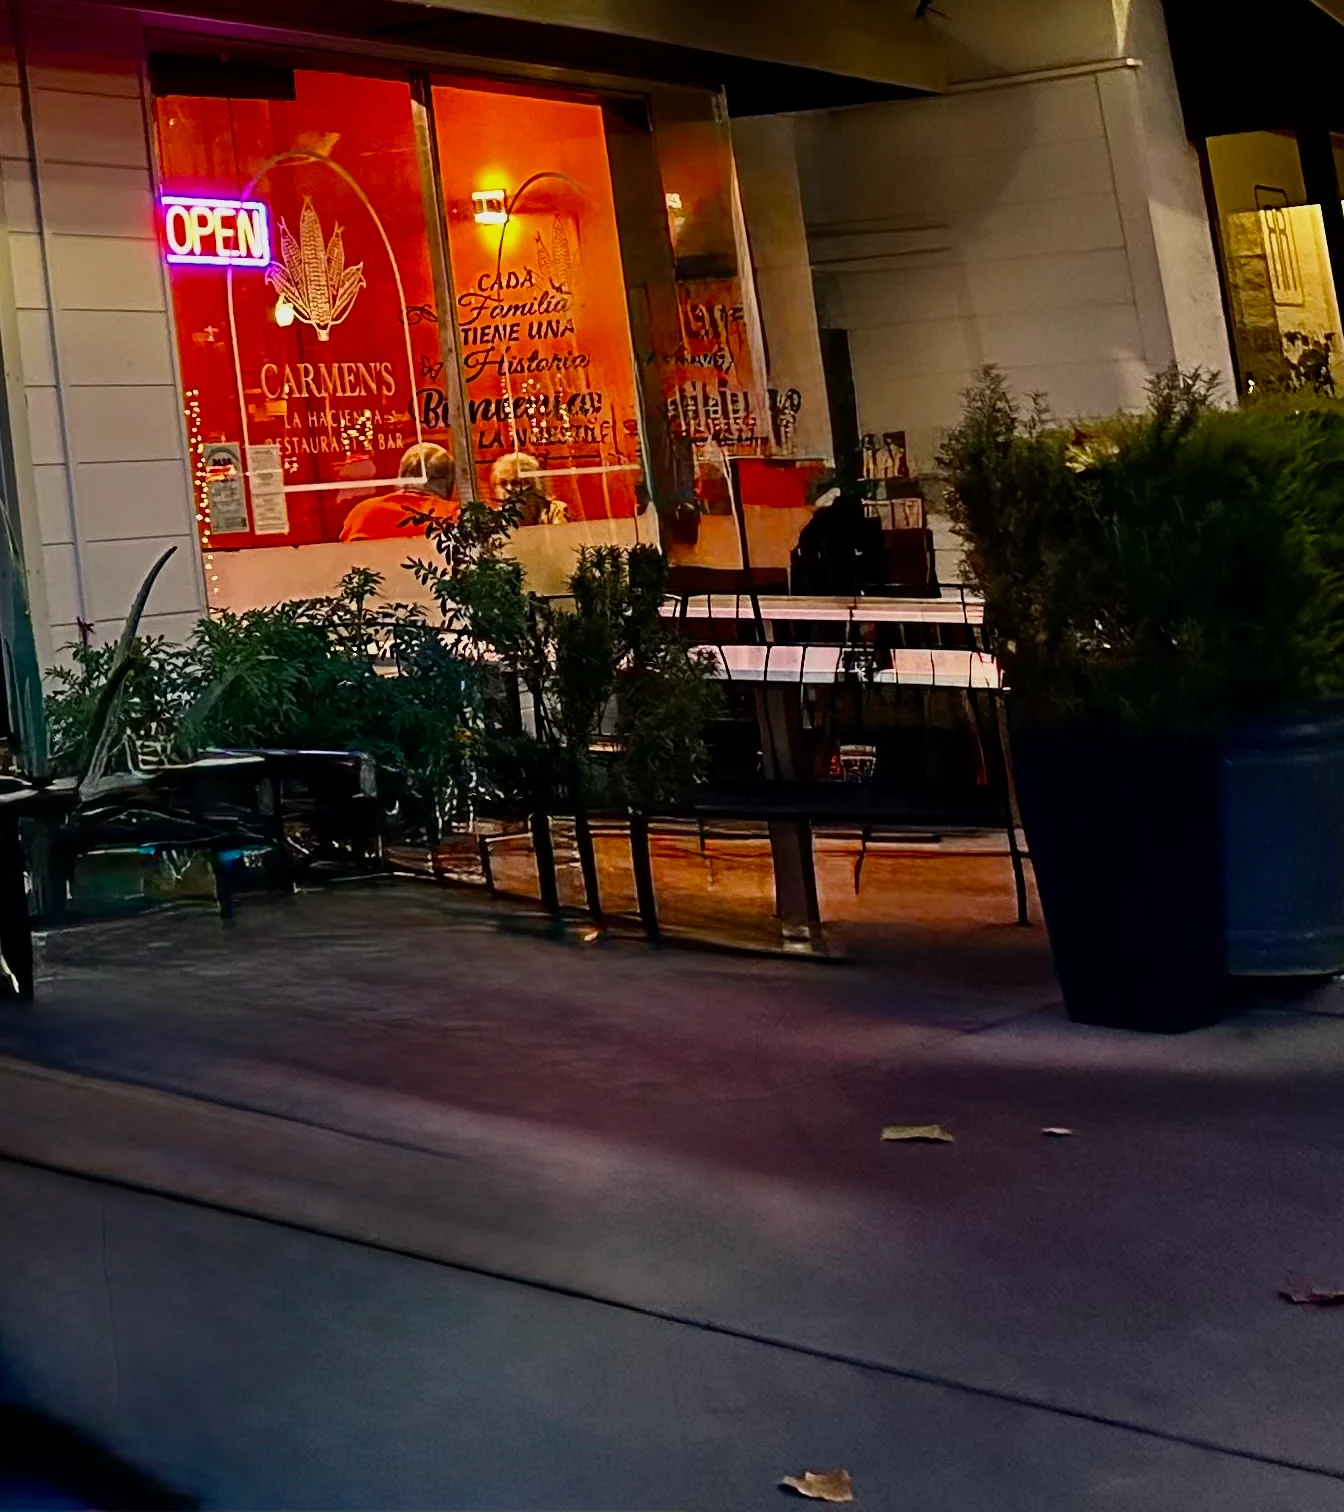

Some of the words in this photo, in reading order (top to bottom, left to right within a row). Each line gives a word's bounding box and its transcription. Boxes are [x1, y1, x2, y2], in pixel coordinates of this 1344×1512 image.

[166, 205, 263, 258] OPEN
[478, 269, 535, 292] CADA
[458, 290, 573, 327] Familia
[461, 321, 521, 346] TIENE
[528, 318, 575, 340] UNA
[463, 345, 591, 383] Historia
[260, 362, 396, 399] CARMEN'S
[284, 411, 302, 429] LA
[308, 408, 383, 428] HACIENA
[378, 432, 405, 450] BAR
[477, 428, 505, 450] LA
